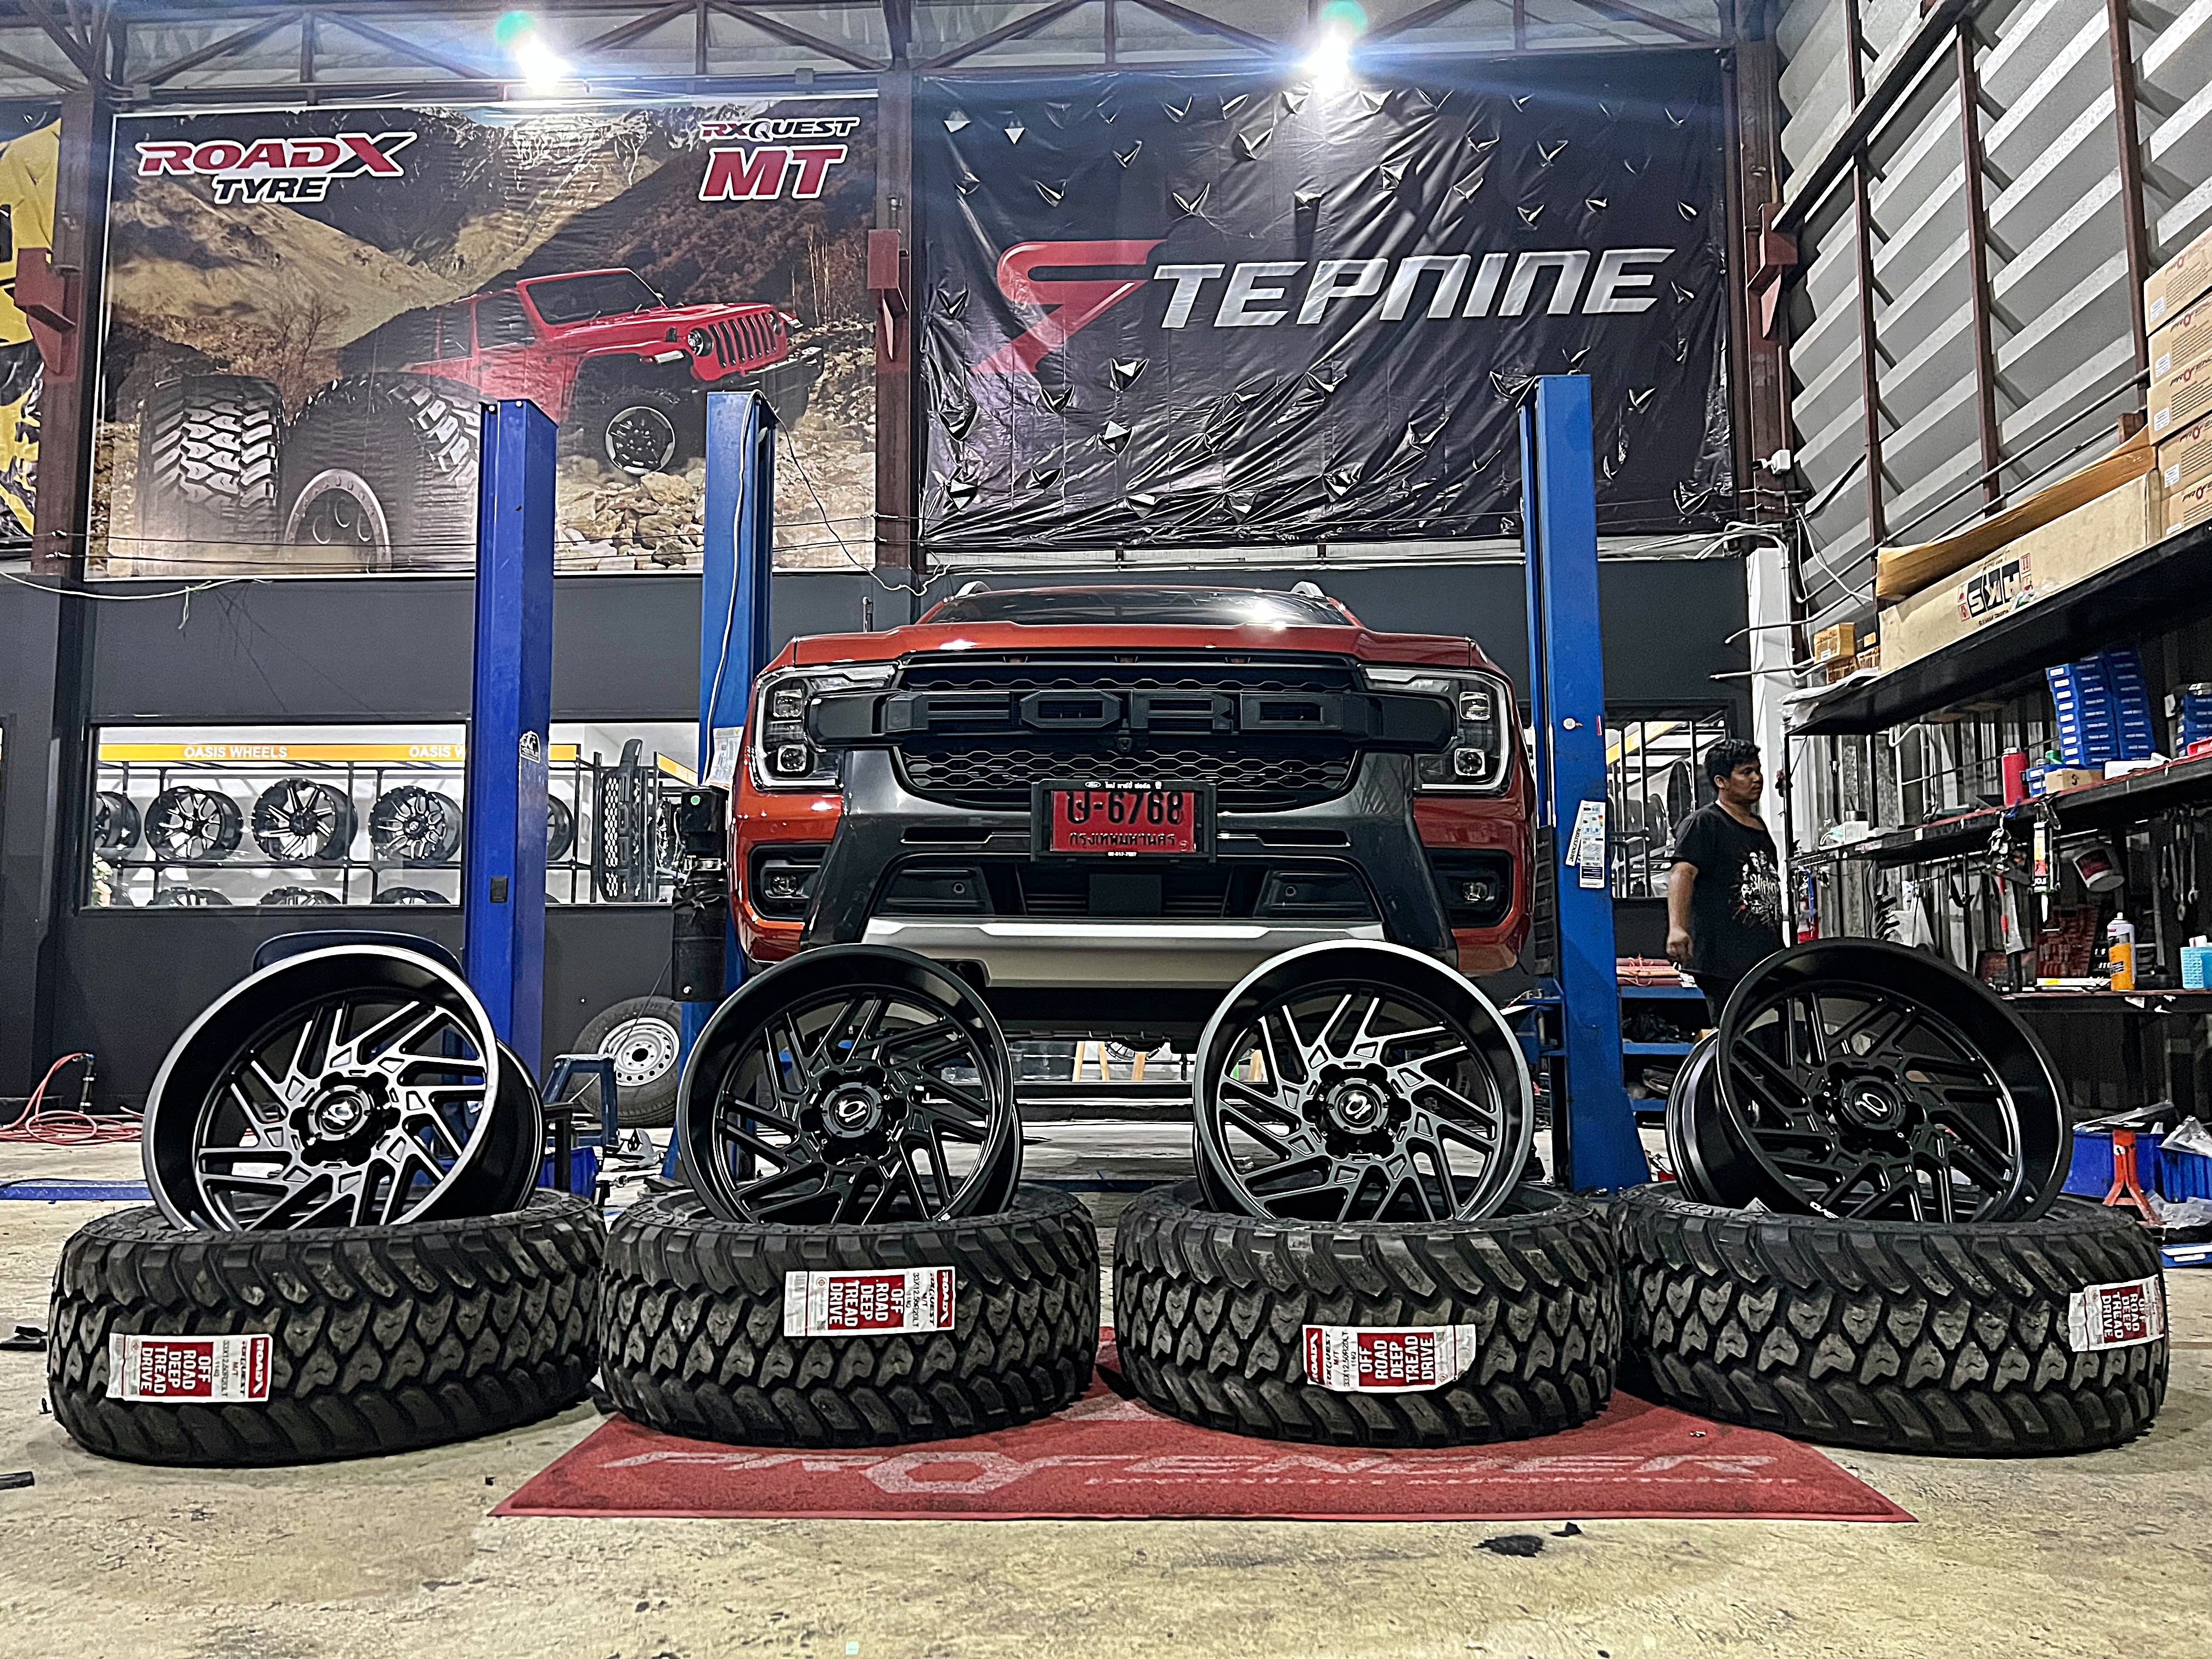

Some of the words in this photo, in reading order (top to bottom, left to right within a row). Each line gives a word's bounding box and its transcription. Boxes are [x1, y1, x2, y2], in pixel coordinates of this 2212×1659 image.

[699, 117, 860, 142] RXQUEST
[137, 132, 416, 177] ROADX
[699, 145, 848, 200] MT
[212, 177, 333, 204] TYRE
[1968, 572, 2021, 614] HKS
[913, 690, 1345, 731] FORD
[184, 746, 225, 759] OASIS
[229, 746, 288, 759] WHEELS
[409, 746, 452, 758] OASIS
[1069, 832, 1175, 849] กรุงเทพมหานคร
[829, 1283, 844, 1324] DRIVE
[845, 1280, 860, 1327] TREAD
[860, 1285, 874, 1321] DEEP
[875, 1283, 889, 1322] ROAD
[890, 1289, 904, 1314] OFF
[2101, 1295, 2114, 1338] DRIVE
[2111, 1291, 2124, 1339] TREAD
[2121, 1296, 2132, 1331] DEEP
[2130, 1293, 2140, 1331] ROAD
[140, 1347, 154, 1391] DRIVE
[154, 1346, 168, 1393] TREAD
[168, 1351, 182, 1388] DEEP
[182, 1350, 196, 1390] ROAD
[198, 1356, 212, 1383] OFF
[1358, 1346, 1373, 1373] OFF
[1374, 1340, 1389, 1379] ROAD
[1389, 1341, 1404, 1378] DEEP
[1405, 1336, 1419, 1383] TREAD
[1420, 1338, 1434, 1380] DRIVE
